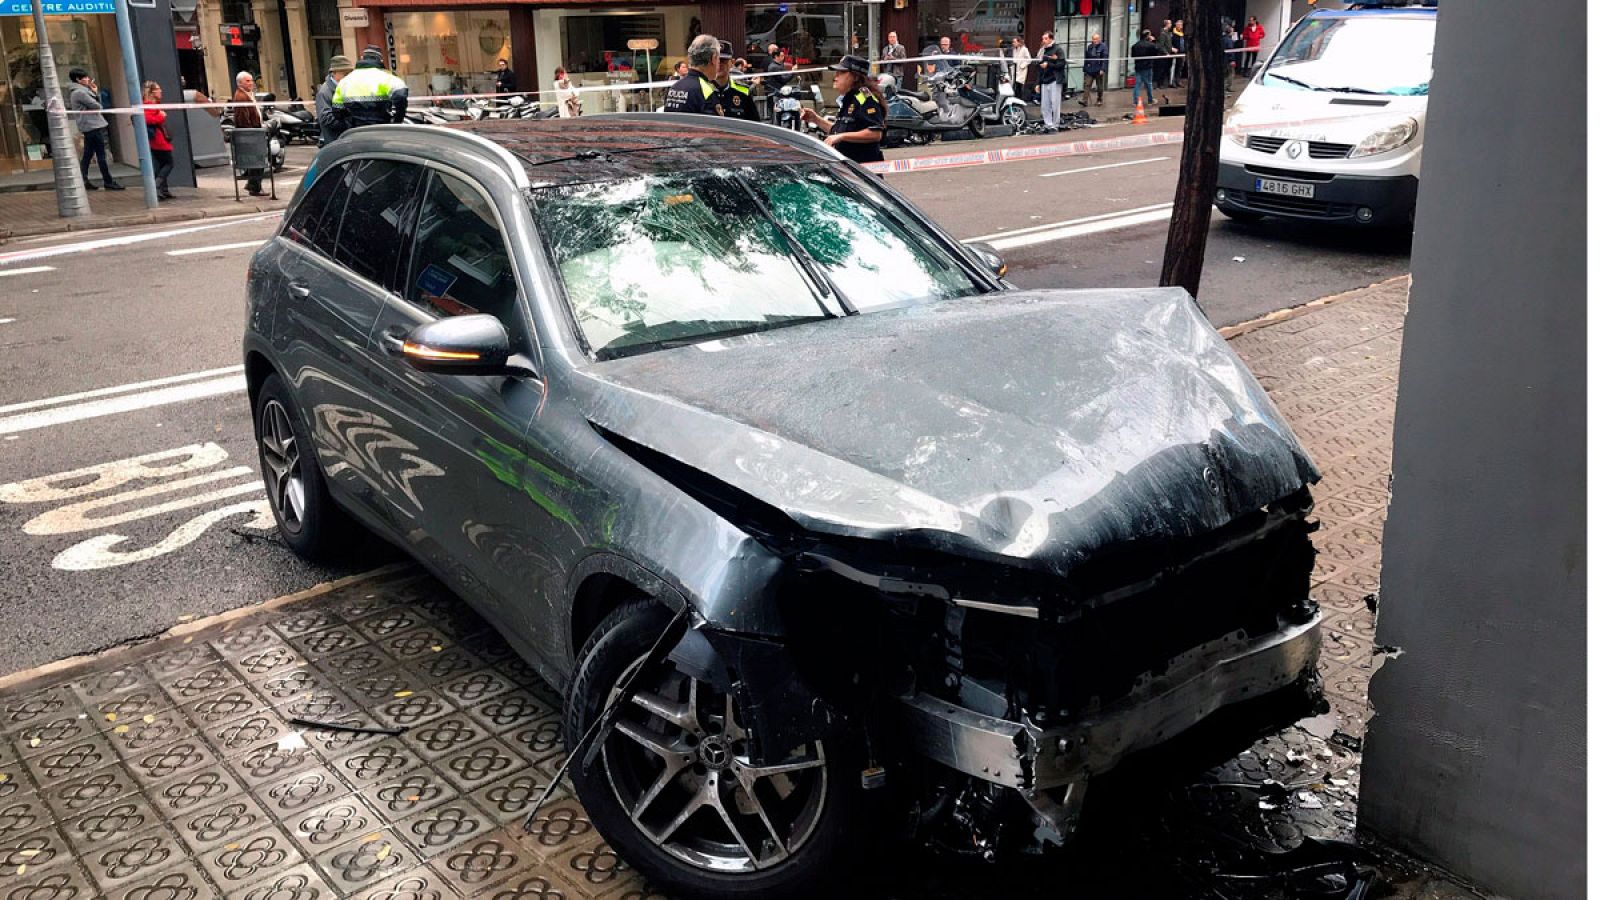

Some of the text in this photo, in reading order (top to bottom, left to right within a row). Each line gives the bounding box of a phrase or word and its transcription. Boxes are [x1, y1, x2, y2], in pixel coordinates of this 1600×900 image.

[12, 4, 63, 12] CERE
[1263, 181, 1312, 196] 4816 GHX
[0, 441, 278, 571] BUS
